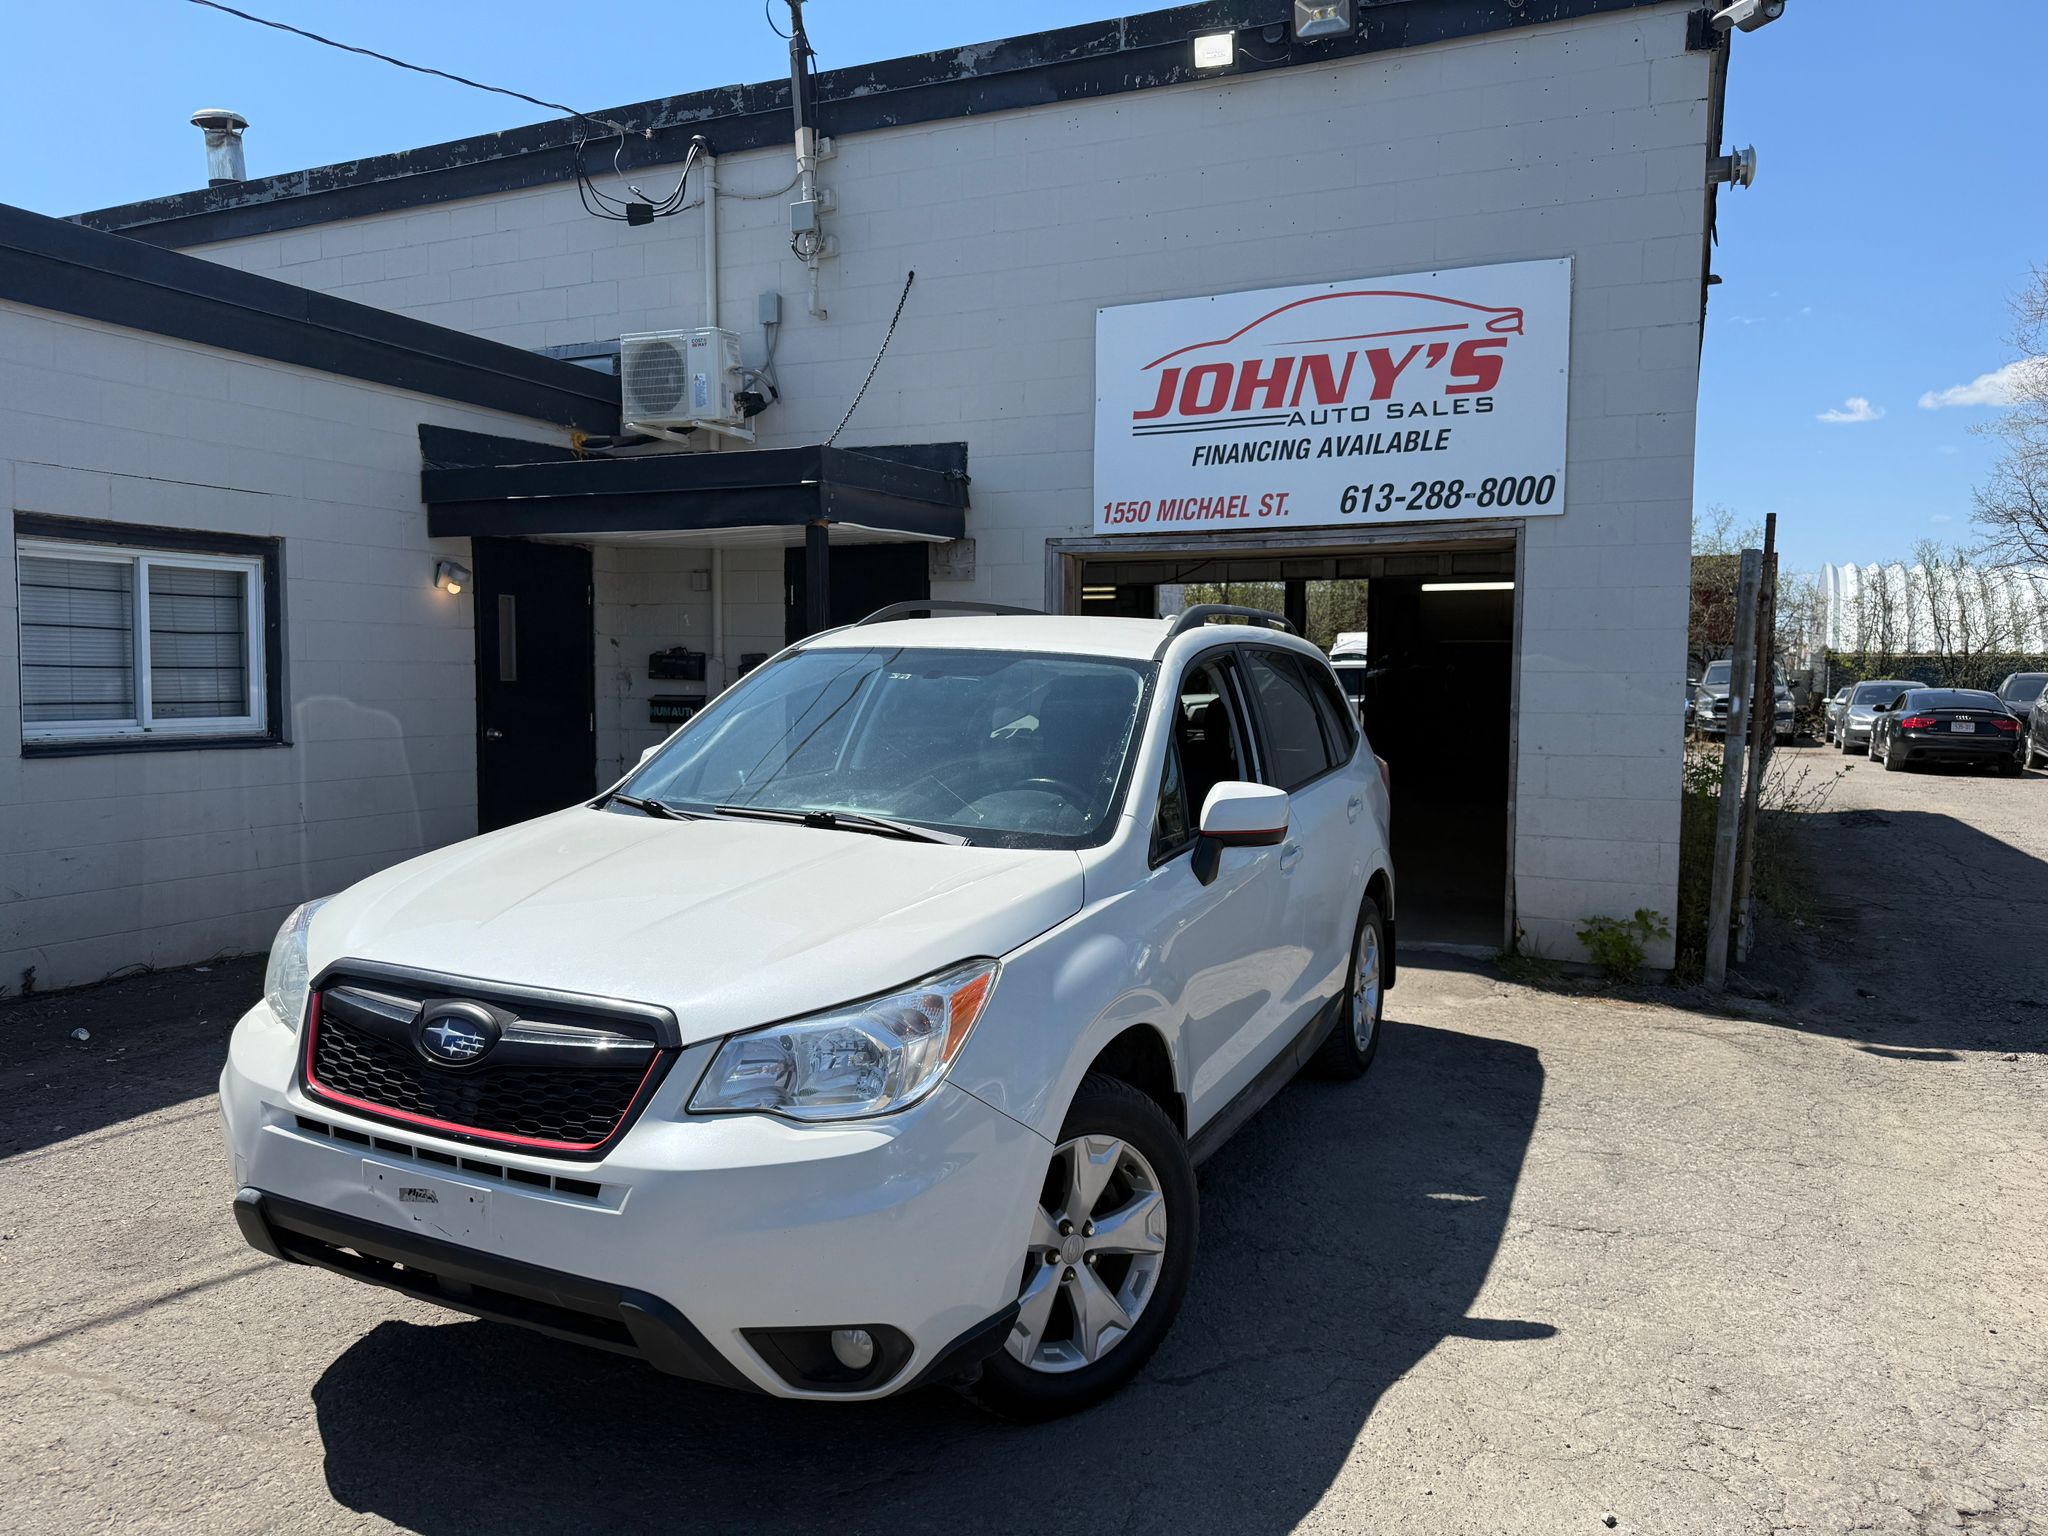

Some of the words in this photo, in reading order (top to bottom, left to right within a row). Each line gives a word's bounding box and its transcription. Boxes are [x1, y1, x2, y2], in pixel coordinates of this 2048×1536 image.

[1133, 337, 1508, 420] JOHNY'S
[1287, 406, 1370, 427] AUTO
[1386, 397, 1494, 420] SALES
[1192, 437, 1311, 466] FINANCING
[1317, 429, 1452, 458] AVAILABLE
[1103, 500, 1151, 524] 1550
[1156, 495, 1250, 522] MICHAEL
[1258, 493, 1290, 517] ST.
[1340, 474, 1556, 514] 613-288-8000
